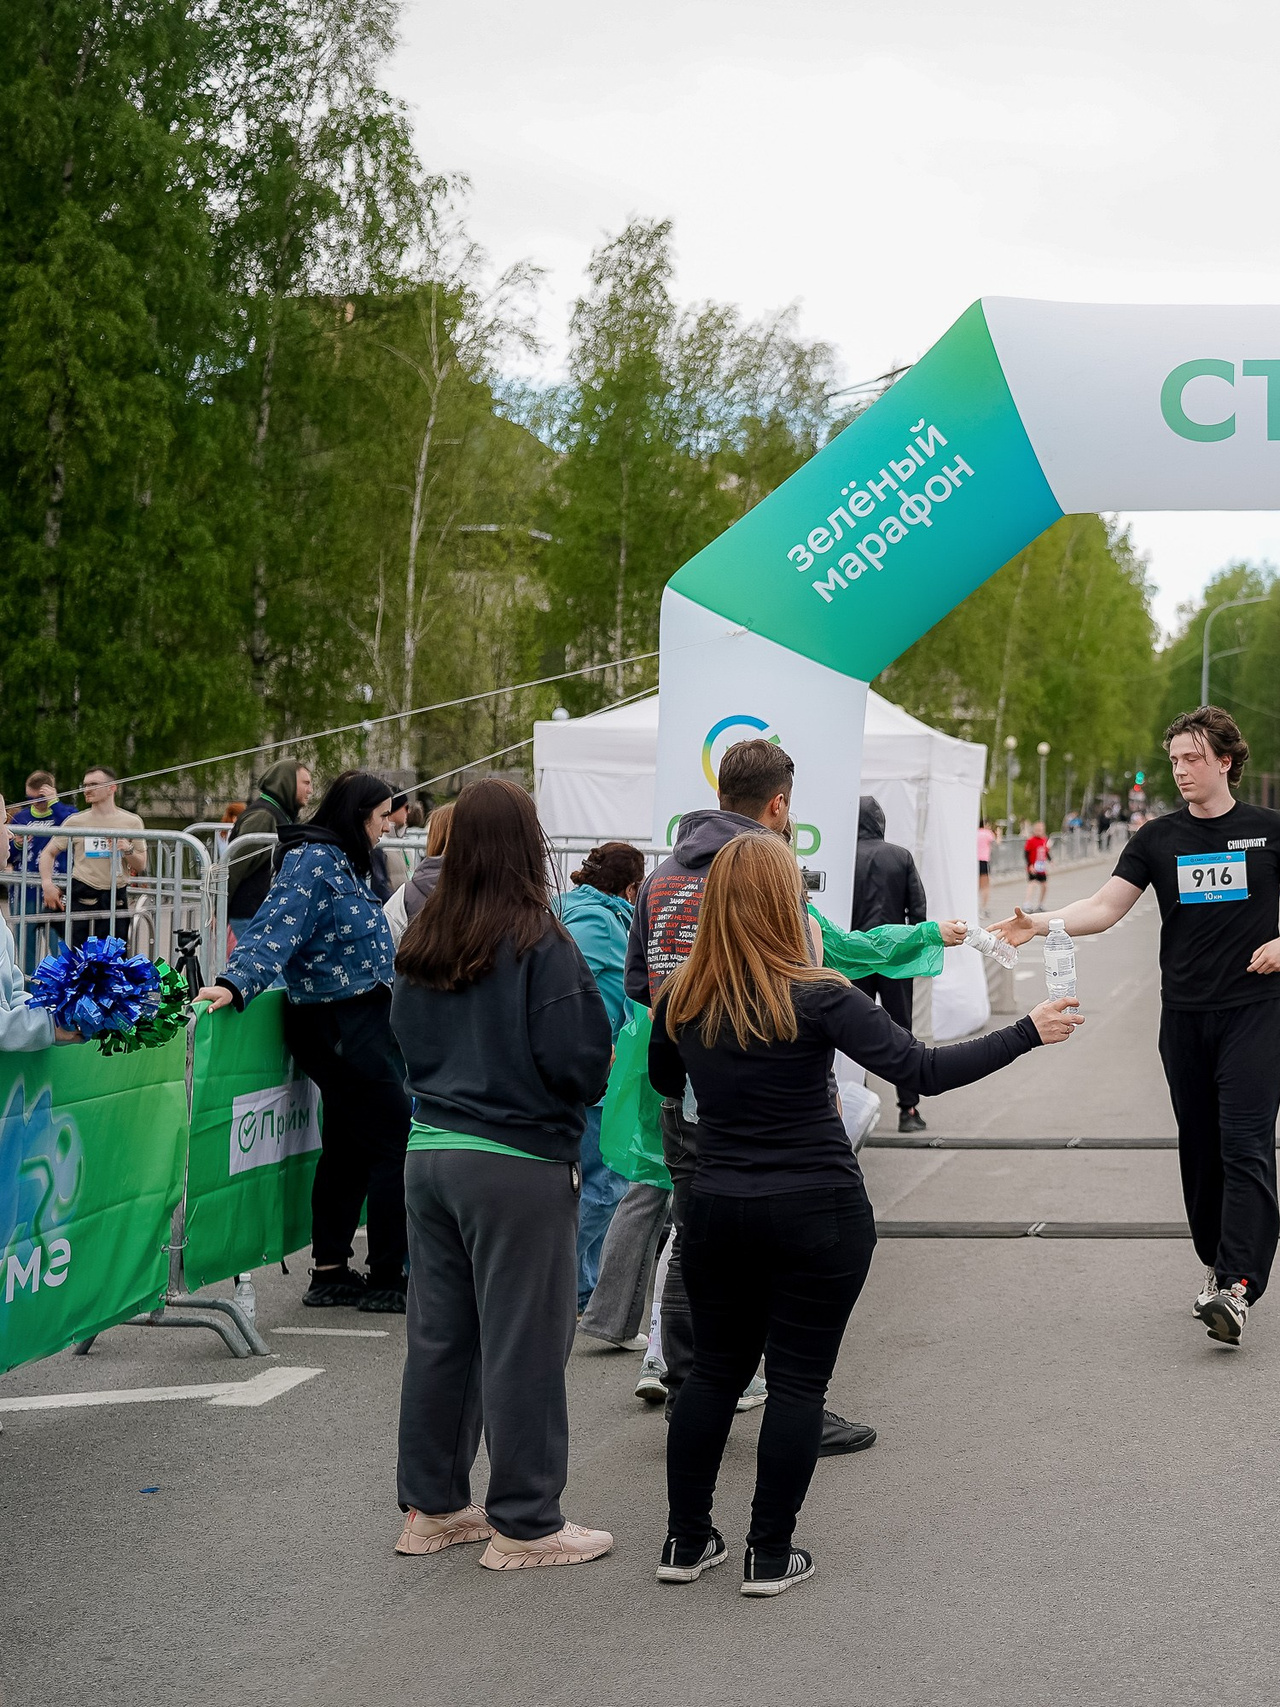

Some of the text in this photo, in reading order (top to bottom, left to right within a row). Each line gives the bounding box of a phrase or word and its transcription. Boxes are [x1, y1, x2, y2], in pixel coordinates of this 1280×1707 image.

[786, 417, 949, 573] зелёный
[811, 453, 976, 604] марафон
[1191, 866, 1233, 888] 916
[260, 1100, 310, 1145] Прйм
